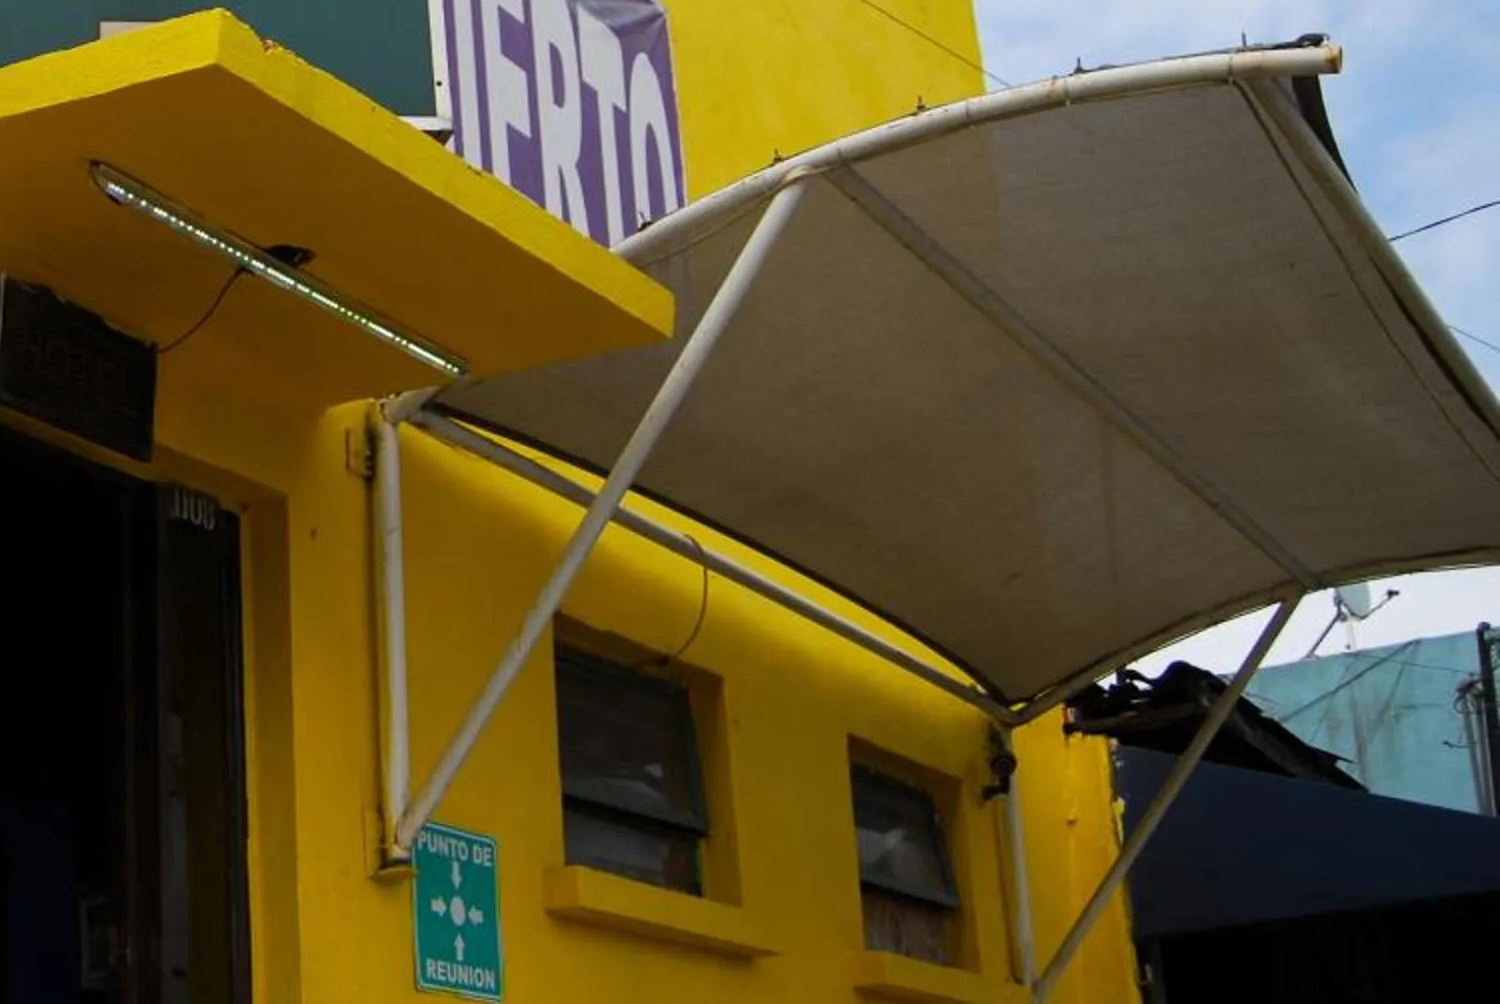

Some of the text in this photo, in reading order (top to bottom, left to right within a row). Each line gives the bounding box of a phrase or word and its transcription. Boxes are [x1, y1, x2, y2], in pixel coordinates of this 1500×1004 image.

[416, 830, 494, 867] PUNTO DE
[426, 958, 496, 992] REUNION
